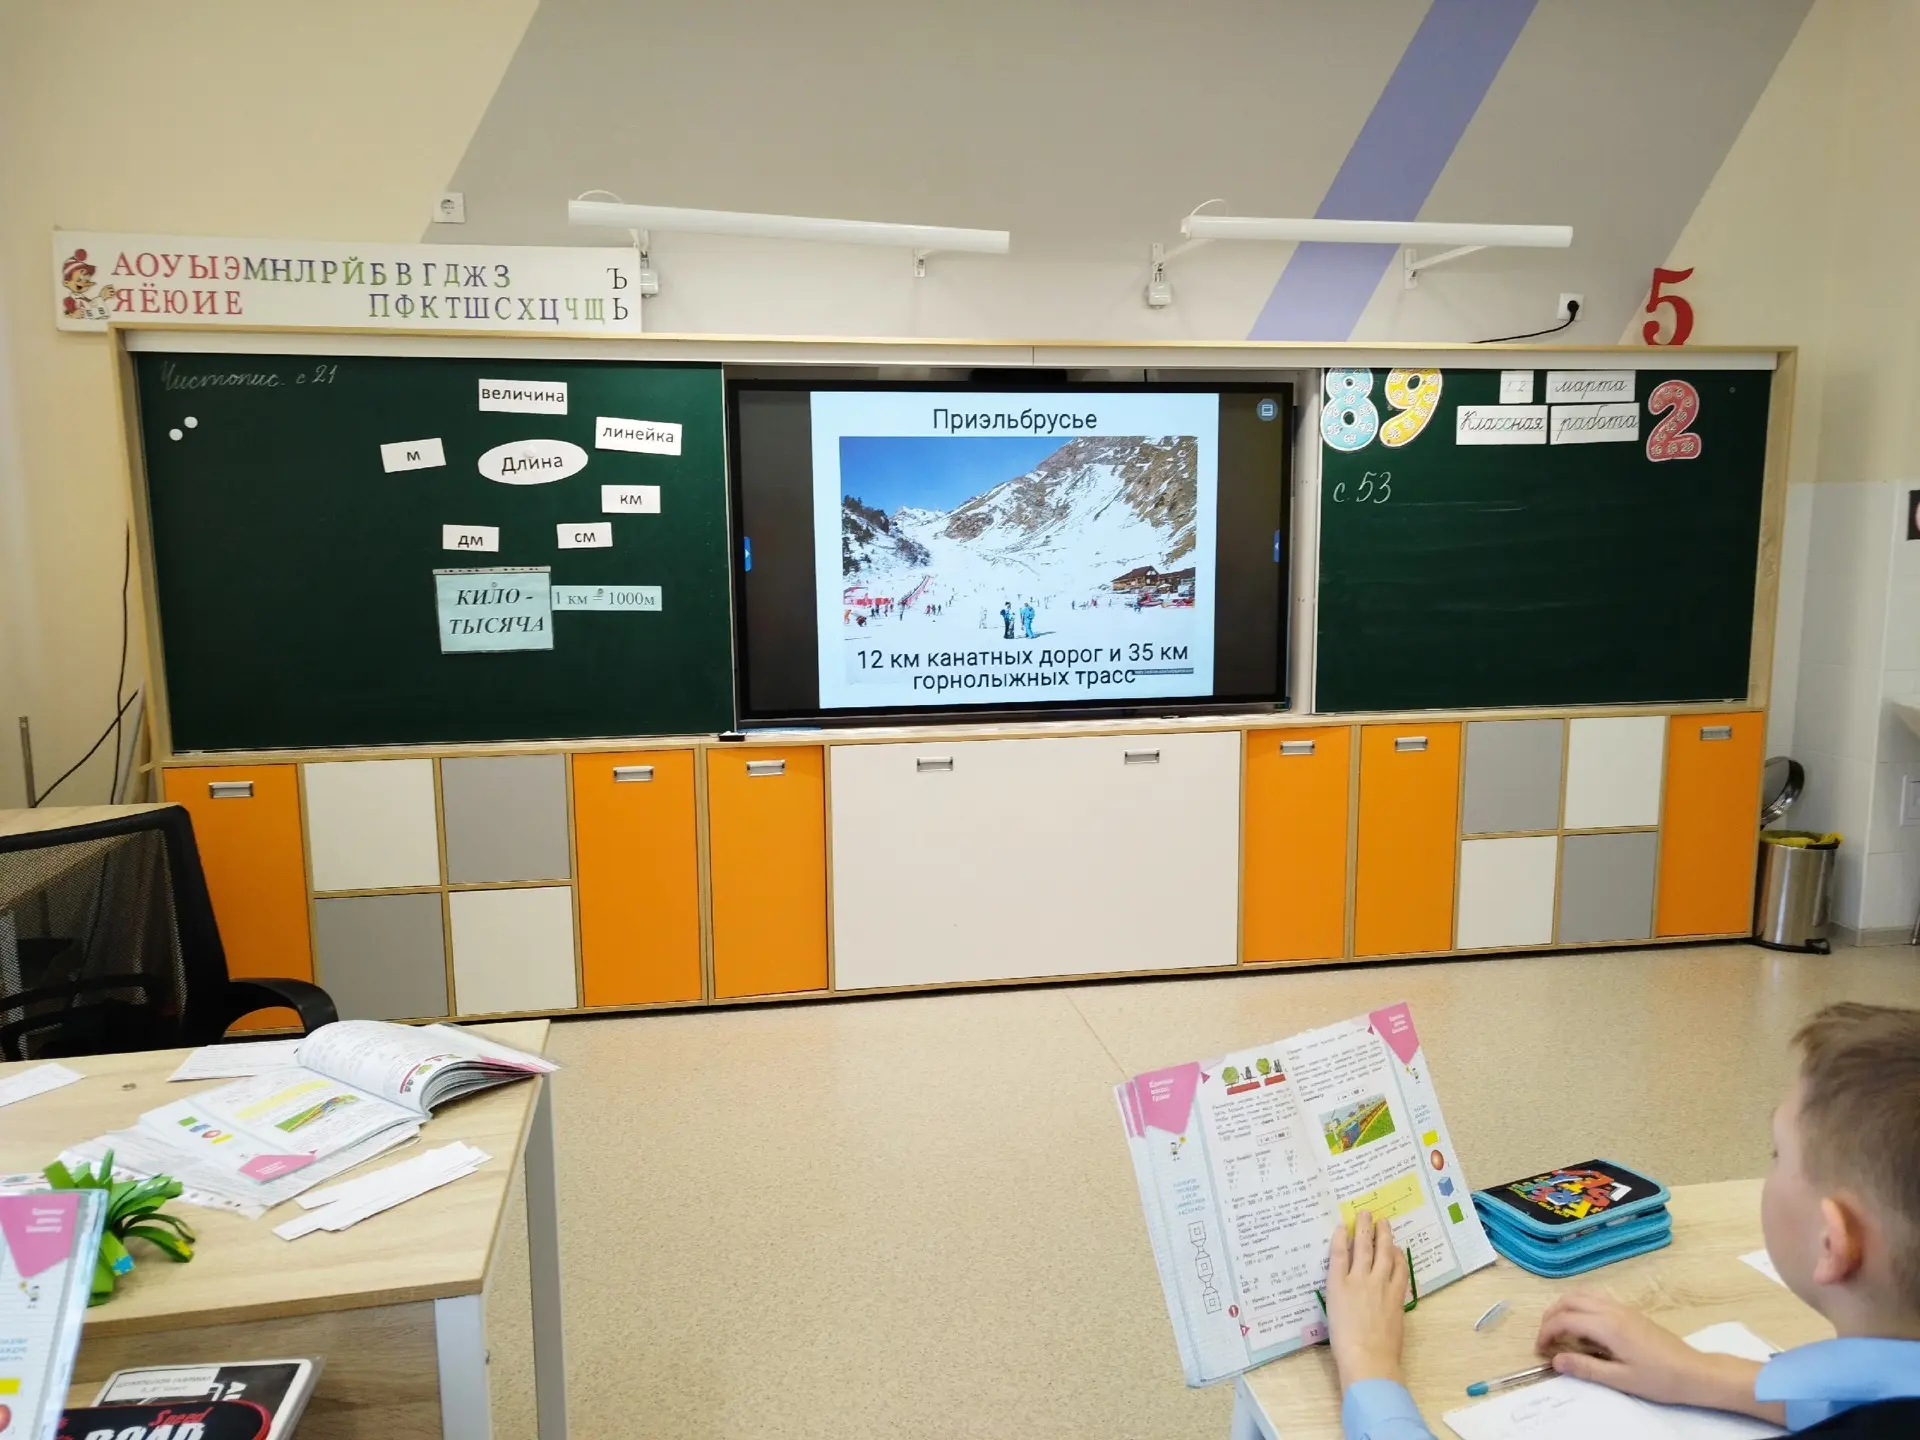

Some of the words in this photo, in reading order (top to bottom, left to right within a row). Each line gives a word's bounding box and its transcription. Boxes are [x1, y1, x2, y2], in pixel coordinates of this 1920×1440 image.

[1643, 267, 1695, 345] 5
[312, 364, 338, 384] 21
[480, 386, 565, 404] величина
[1555, 379, 1628, 400] марта
[1321, 368, 1379, 451] 8
[1380, 368, 1443, 447] 9
[933, 408, 1098, 434] Приэльбрусье
[1459, 410, 1545, 431] Классная
[1556, 404, 1639, 442] работа
[1646, 380, 1702, 462] 2
[602, 425, 675, 444] линейка
[406, 450, 421, 462] м
[501, 455, 564, 476] Длина
[1356, 470, 1392, 504] 53
[619, 493, 643, 506] км
[457, 534, 484, 548] дм
[573, 530, 597, 544] см
[455, 587, 521, 606] КИЛО
[556, 591, 561, 605] 1
[567, 594, 588, 606] км
[449, 615, 545, 635] ТЫСЯЧА
[857, 650, 884, 669] 12
[890, 652, 920, 668] км
[927, 649, 1034, 667] канатных
[1038, 649, 1104, 668] дорог
[1109, 648, 1122, 662] и
[1128, 643, 1154, 662] 35
[1160, 645, 1189, 661] км
[913, 669, 1070, 694] горнолыжных
[1075, 669, 1137, 690] трасс
